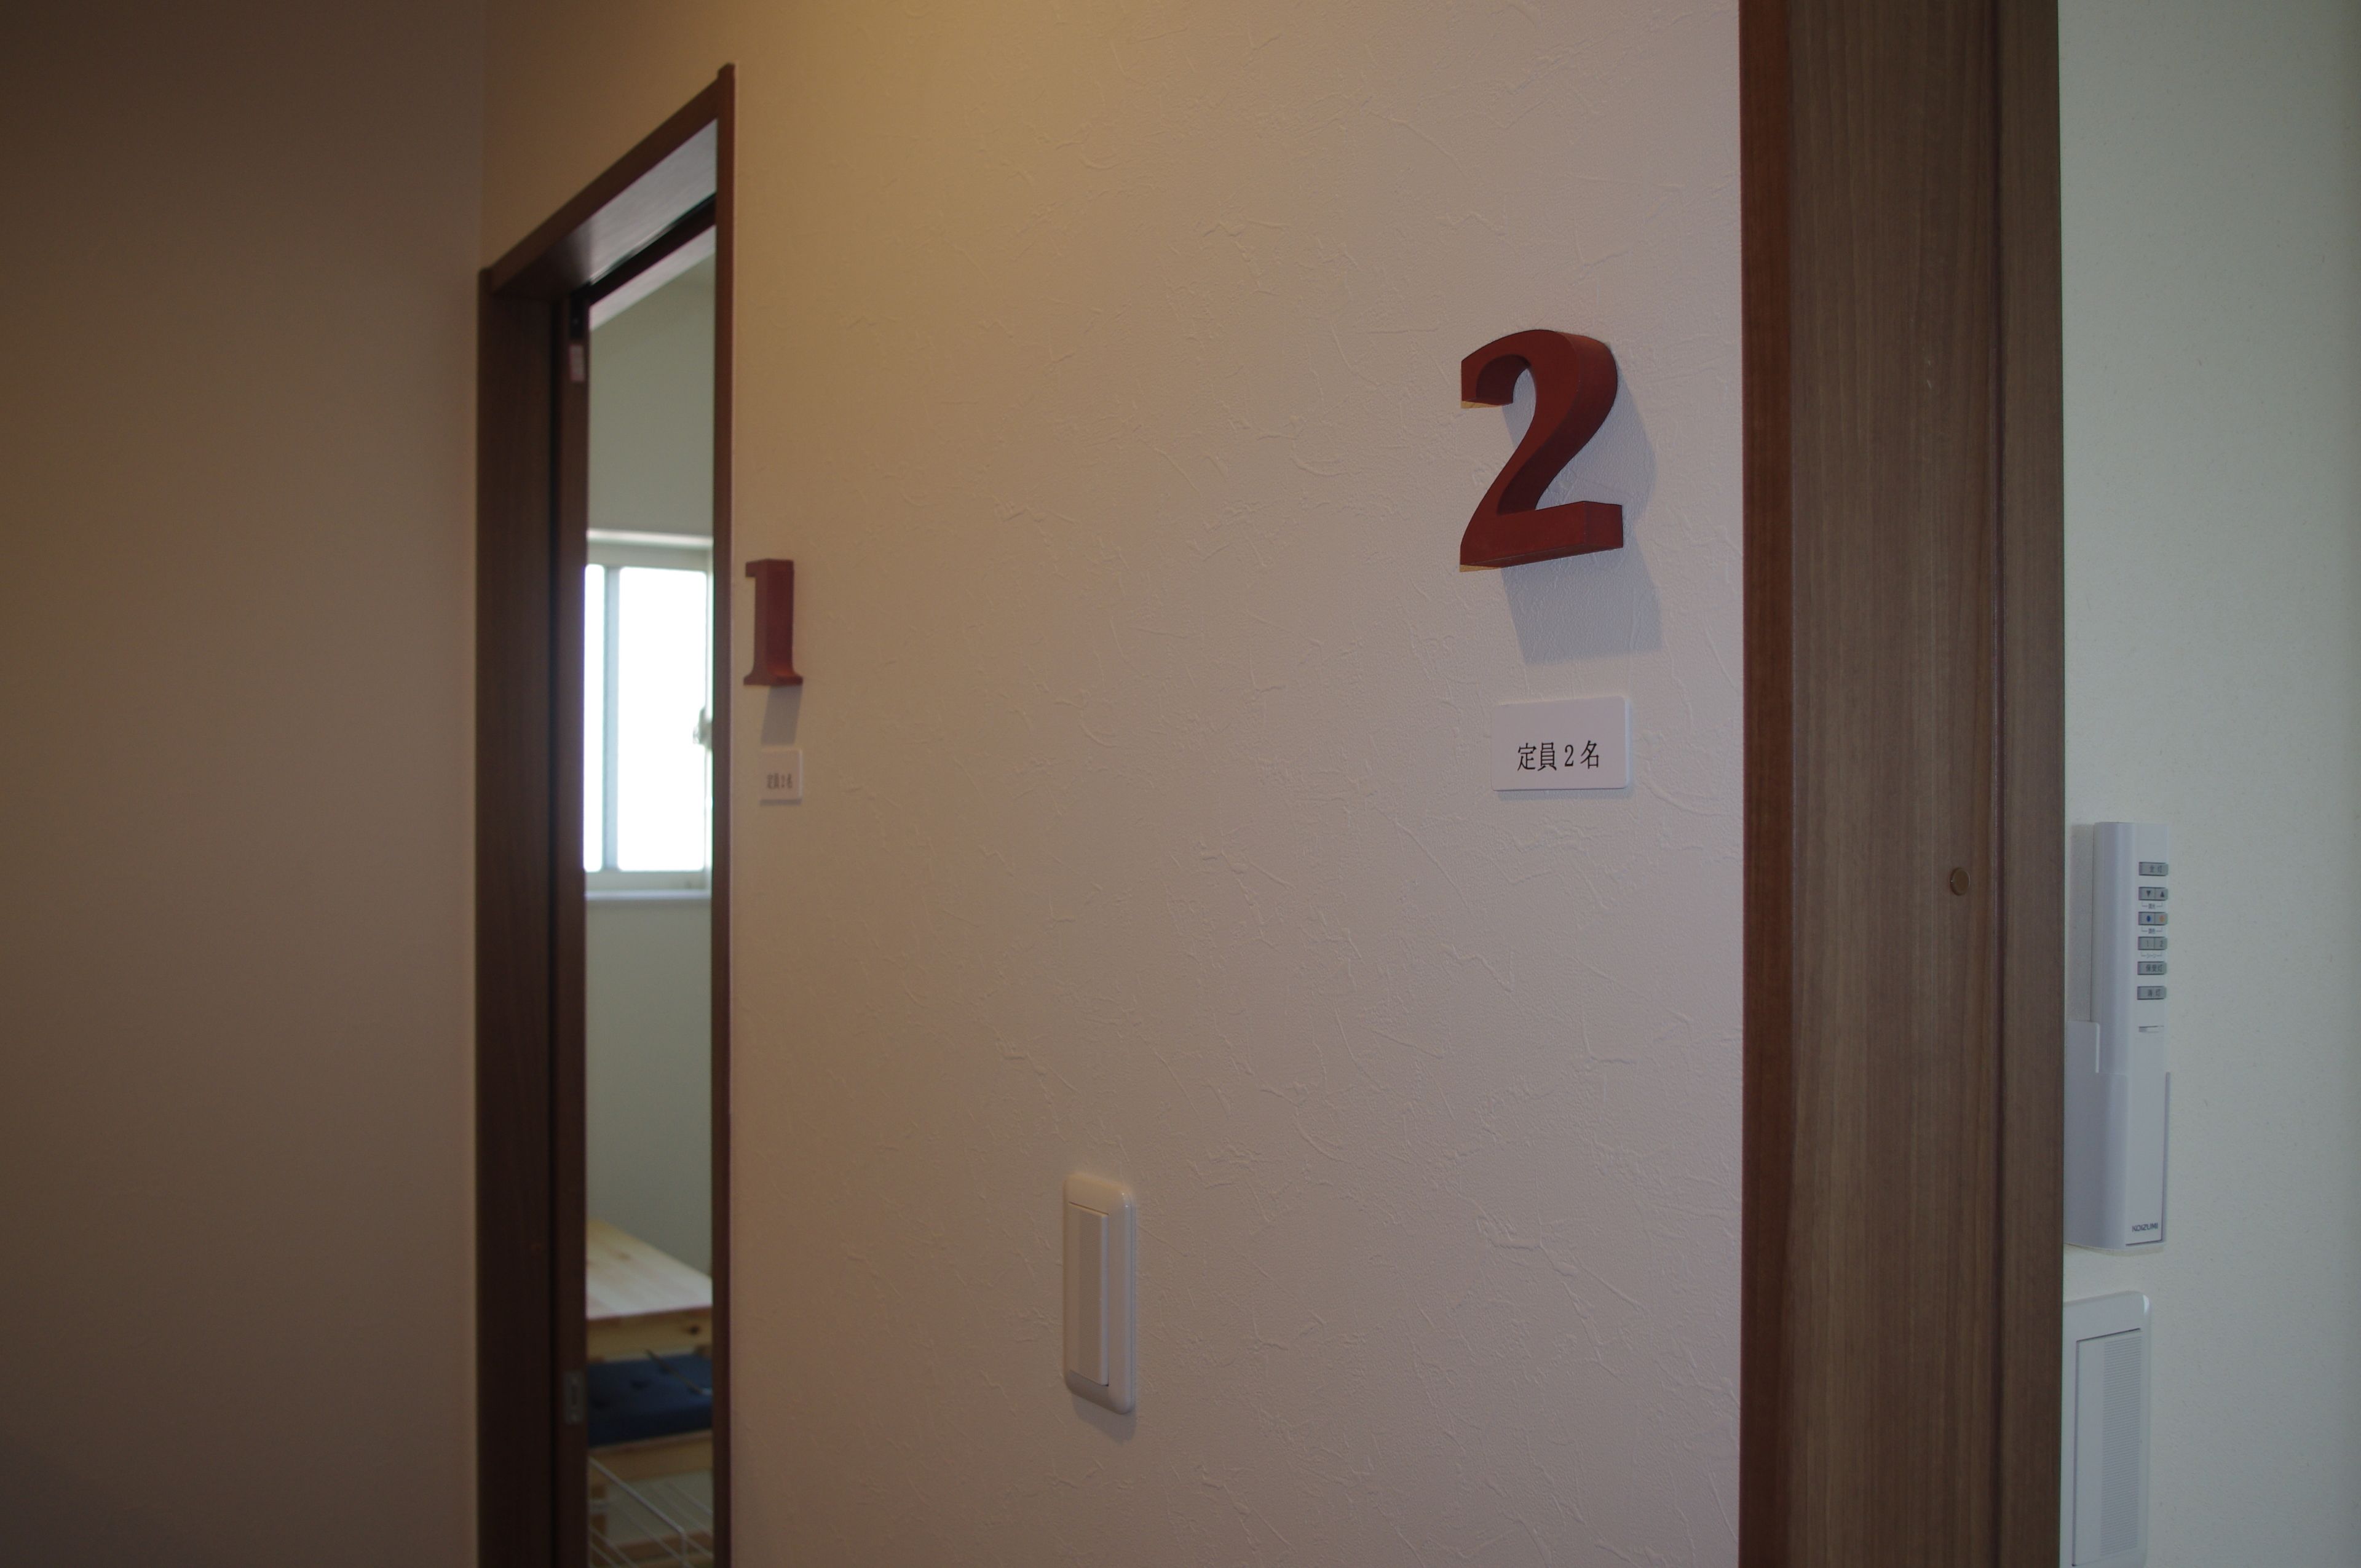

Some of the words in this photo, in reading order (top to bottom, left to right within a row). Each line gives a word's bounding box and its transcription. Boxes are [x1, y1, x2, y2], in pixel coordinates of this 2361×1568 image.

[1460, 329, 1623, 572] 2
[743, 558, 803, 686] 1
[1517, 740, 1599, 771] 定員2名
[2132, 1222, 2158, 1232] KOIZUMI
